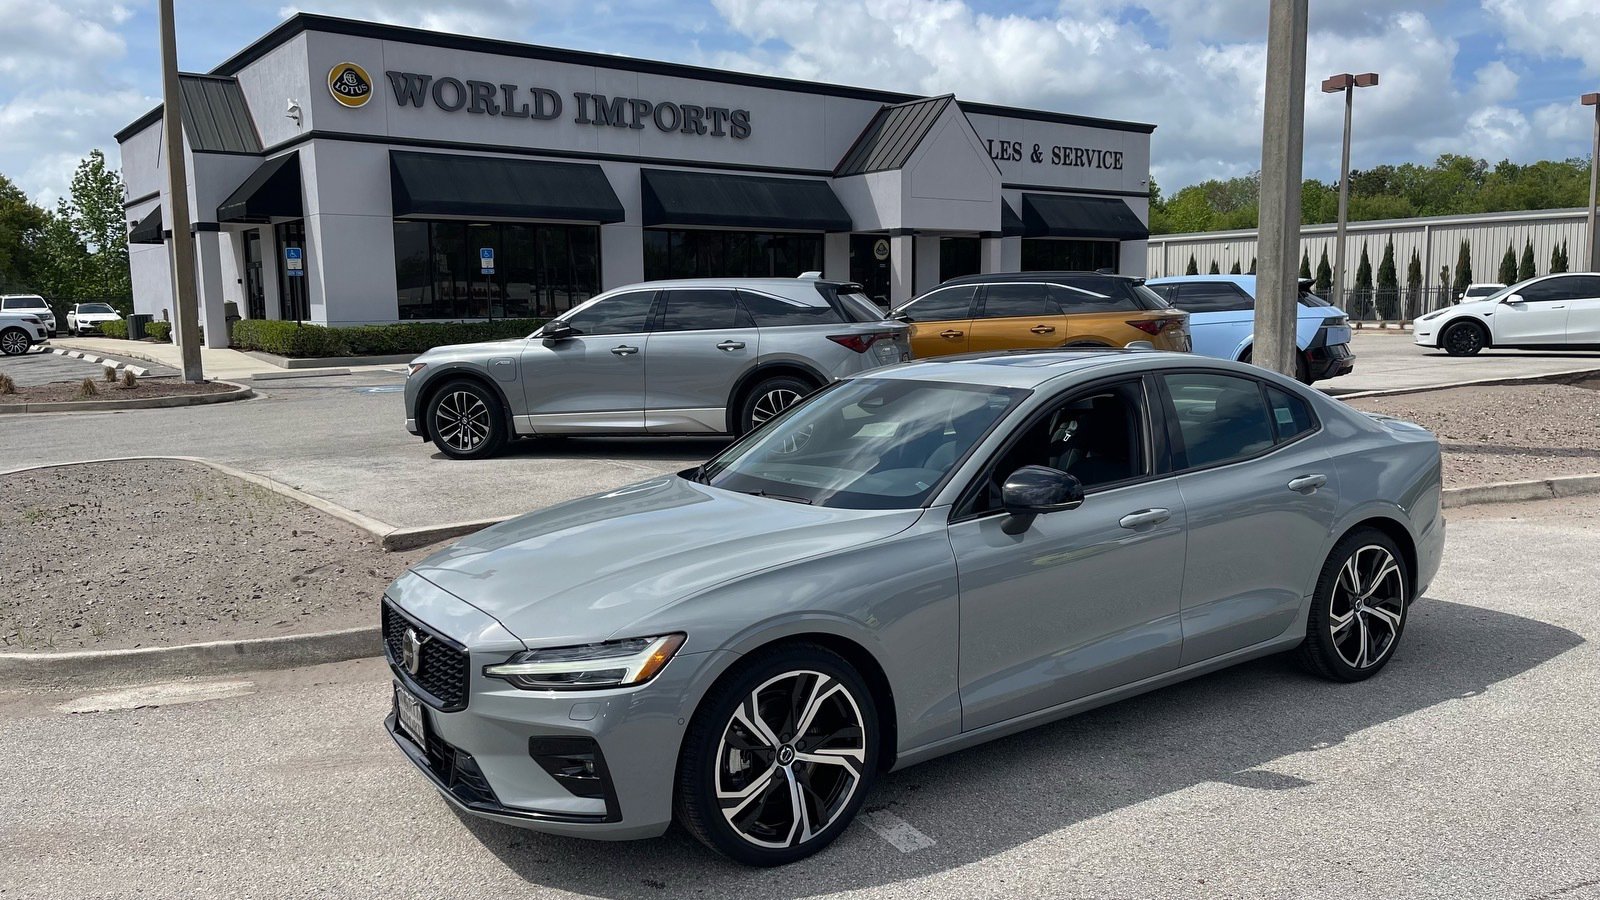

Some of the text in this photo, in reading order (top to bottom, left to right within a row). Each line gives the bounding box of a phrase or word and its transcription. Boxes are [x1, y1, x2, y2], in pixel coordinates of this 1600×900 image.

[335, 82, 368, 94] LOTUS
[386, 71, 751, 139] WORLD IMPORTS
[987, 139, 1123, 170] LES & SERVICE
